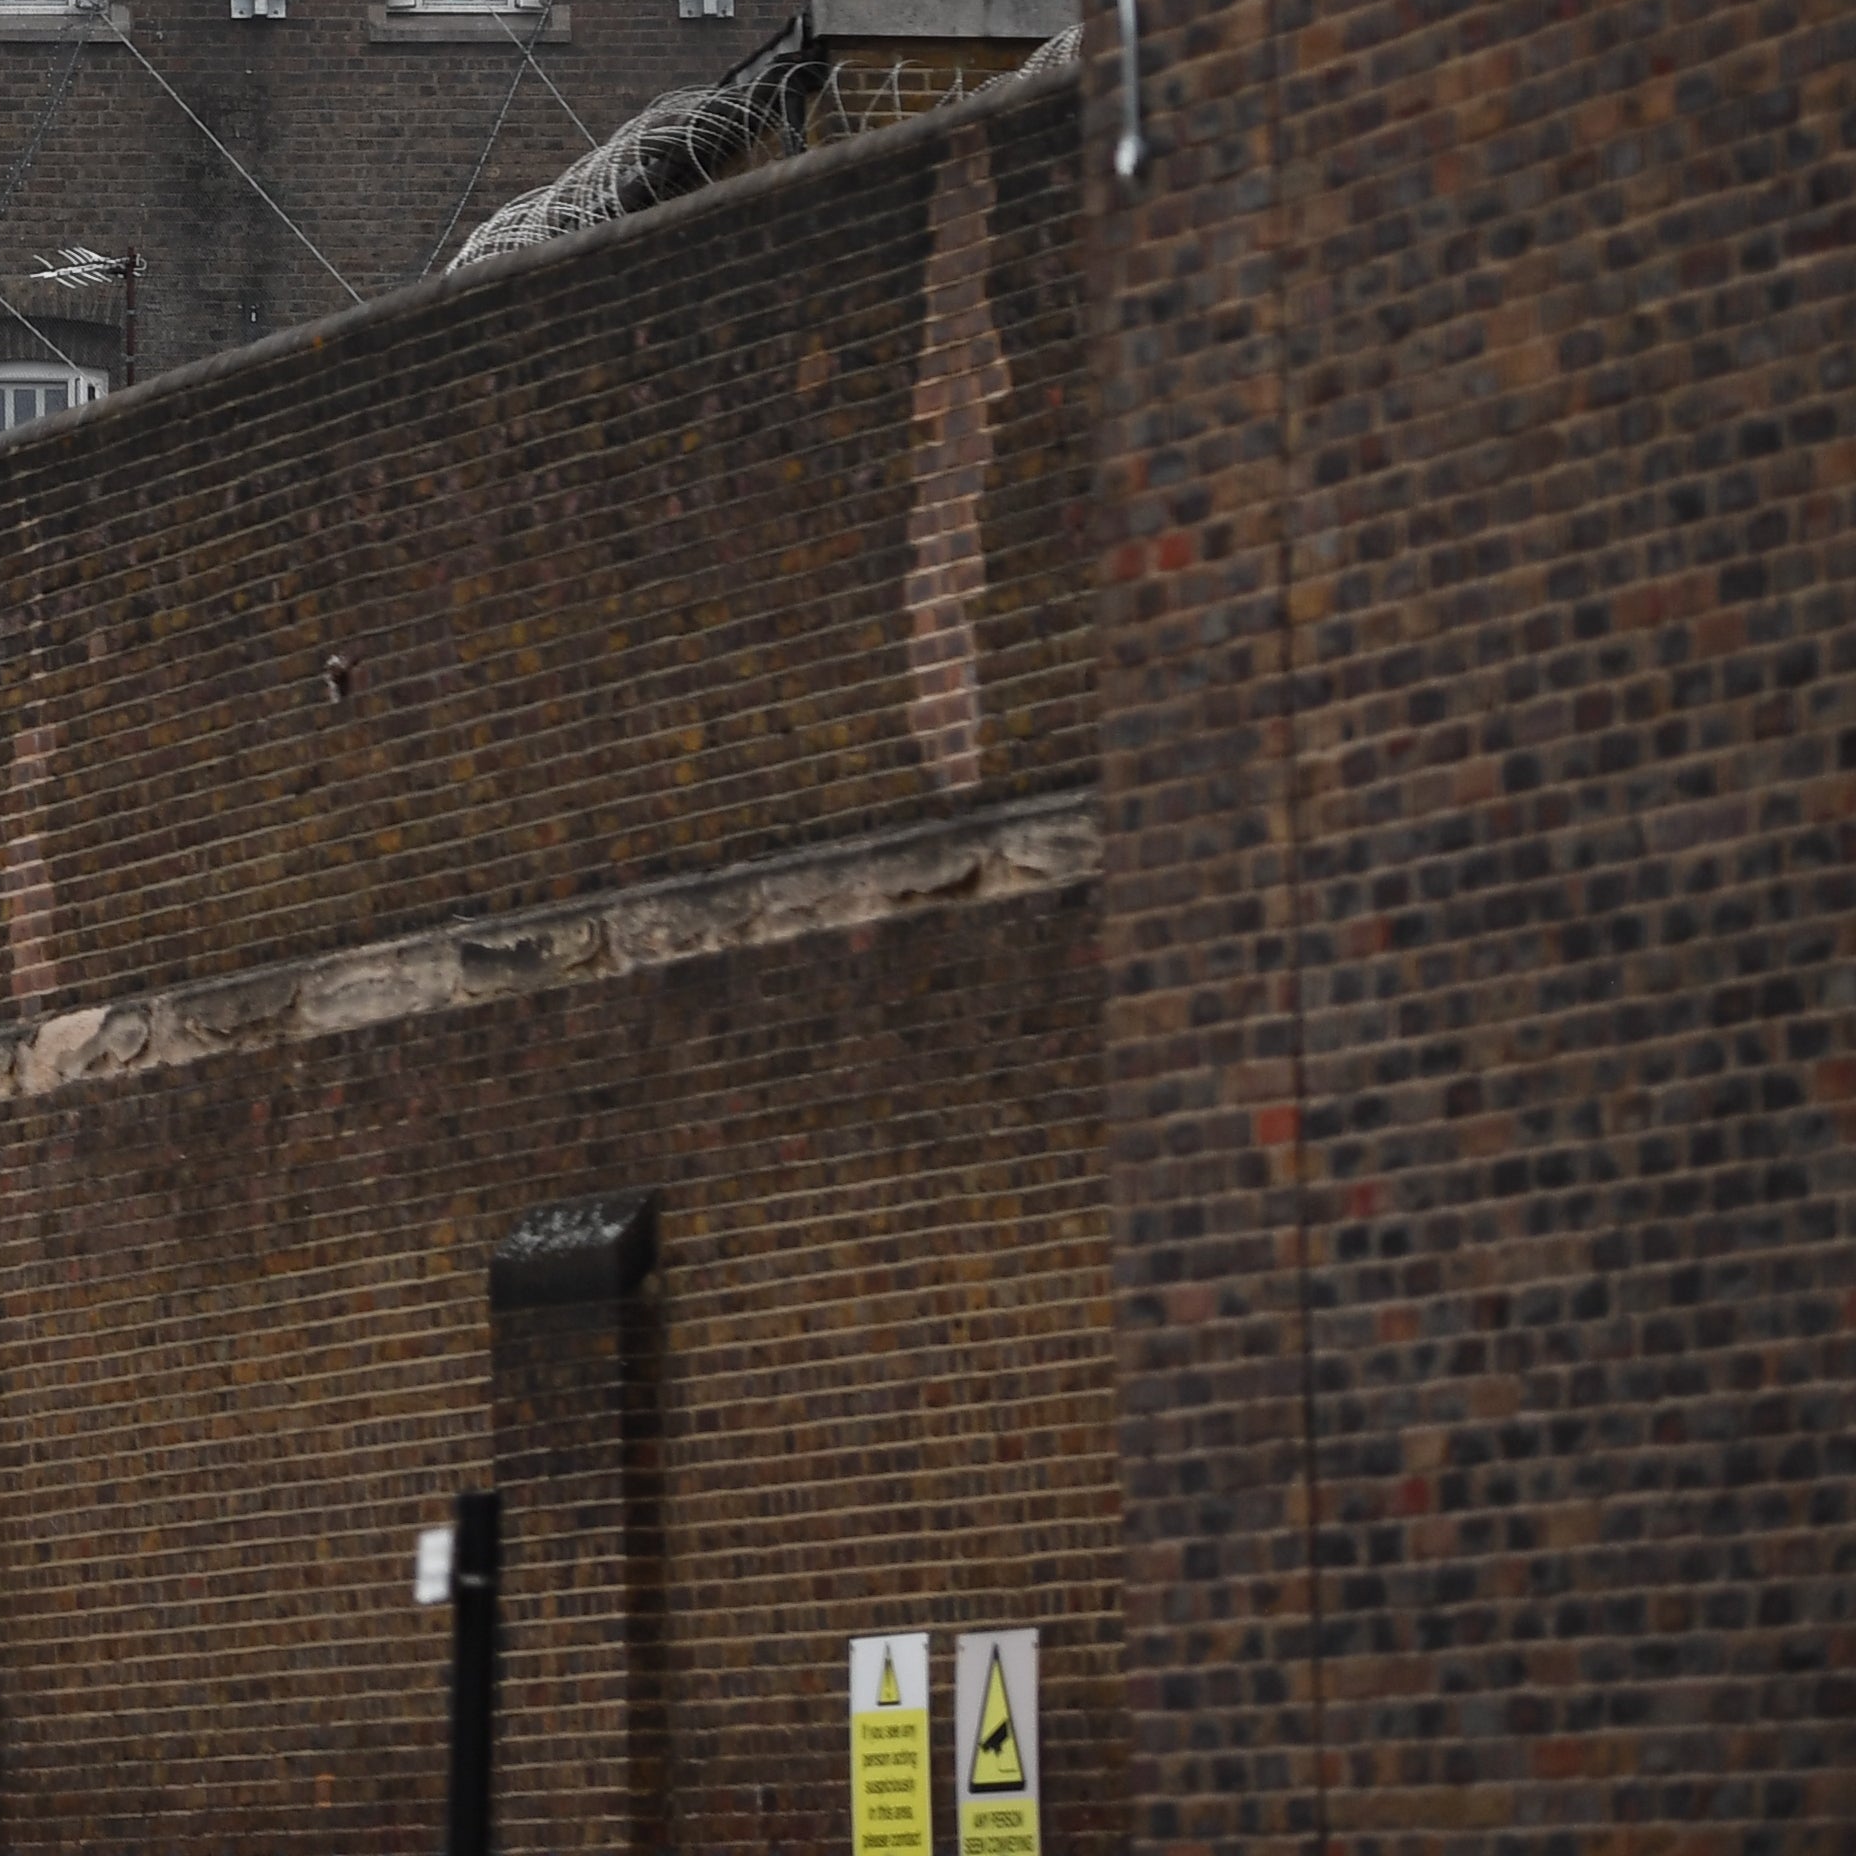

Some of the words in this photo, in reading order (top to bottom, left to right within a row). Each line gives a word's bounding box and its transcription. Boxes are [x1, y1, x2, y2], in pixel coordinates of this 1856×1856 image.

[862, 1752, 890, 1770] person
[892, 1750, 918, 1769] acting
[864, 1777, 916, 1796] suspiciously
[991, 1810, 1024, 1829] PERSON
[862, 1832, 889, 1850] please
[890, 1832, 922, 1847] contact
